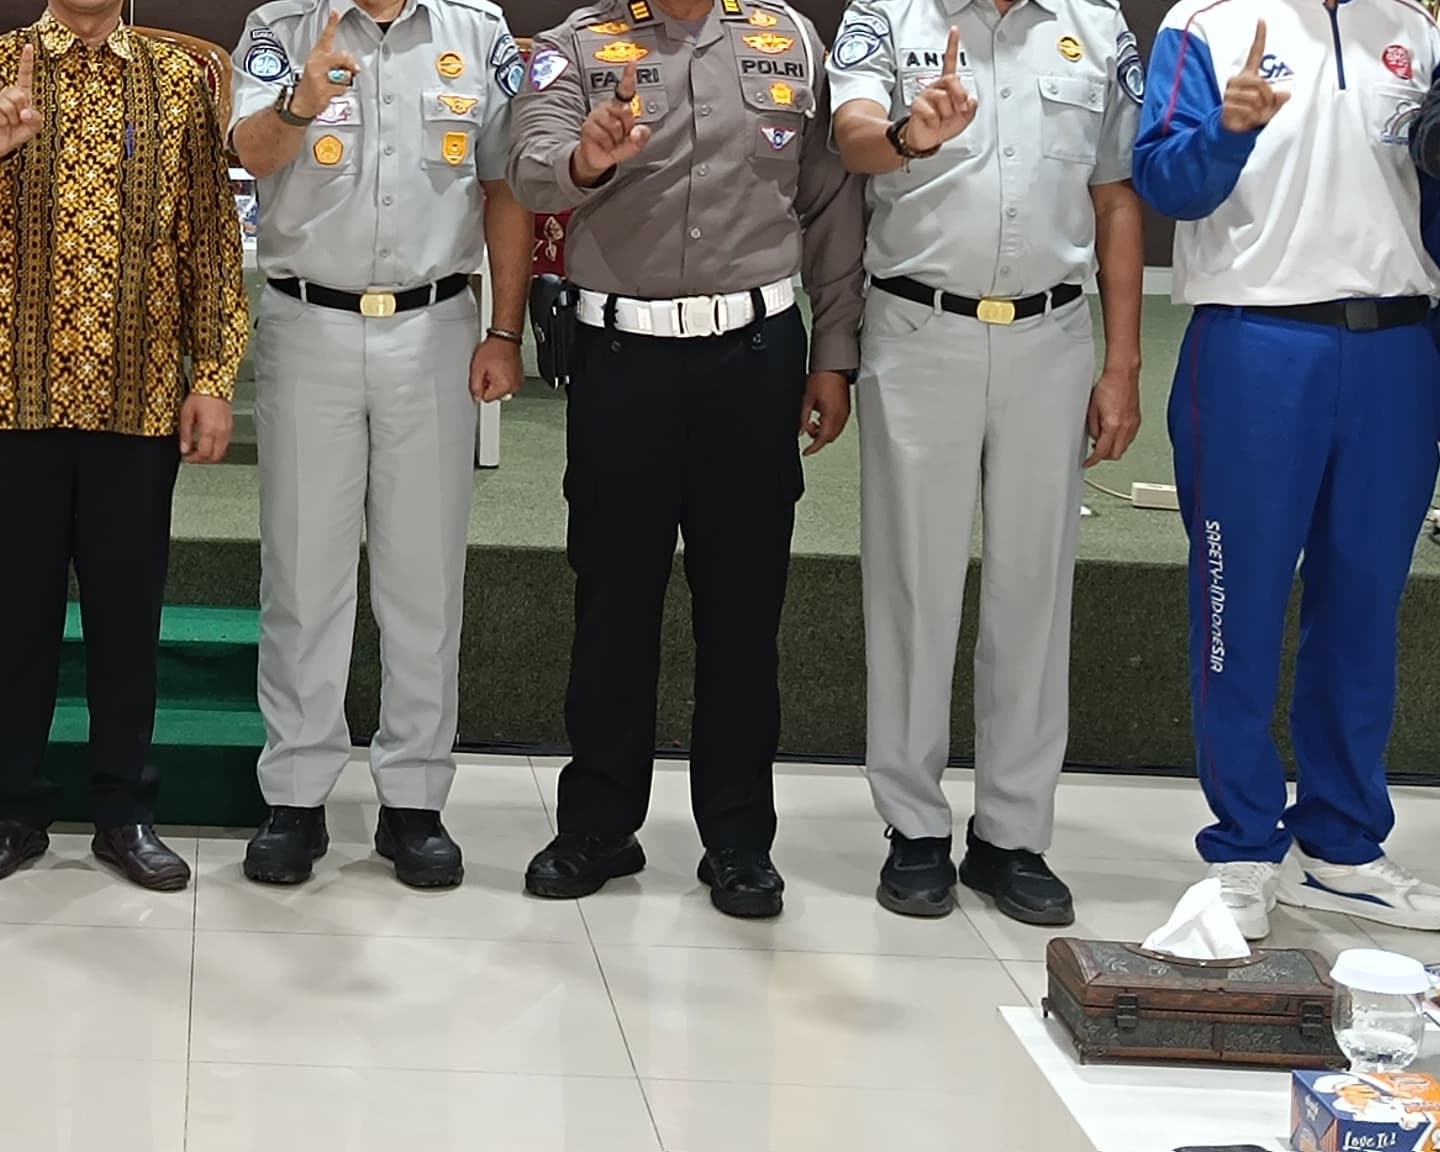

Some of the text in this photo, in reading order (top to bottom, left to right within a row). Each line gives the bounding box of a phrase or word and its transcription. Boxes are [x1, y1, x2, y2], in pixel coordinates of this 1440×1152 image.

[741, 59, 804, 78] POLRI
[906, 51, 967, 67] ANI
[590, 67, 660, 88] FARI
[1343, 1131, 1376, 1151] Love
